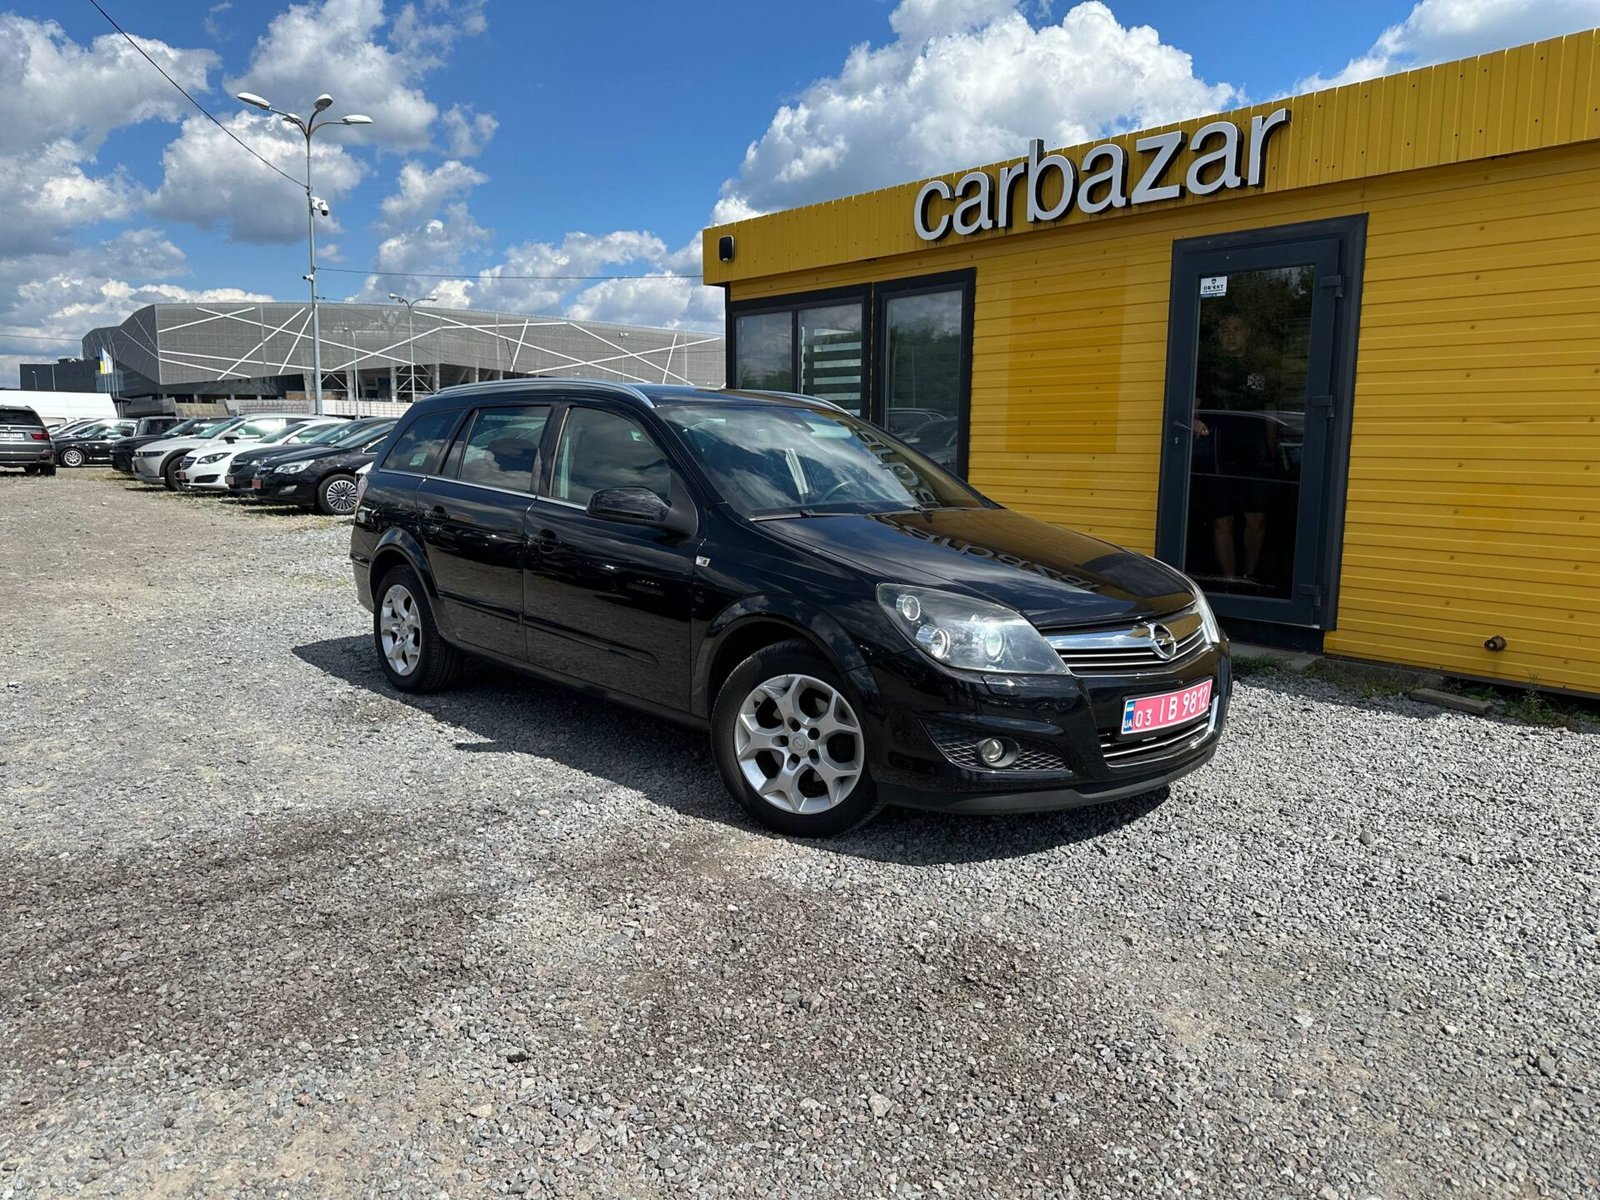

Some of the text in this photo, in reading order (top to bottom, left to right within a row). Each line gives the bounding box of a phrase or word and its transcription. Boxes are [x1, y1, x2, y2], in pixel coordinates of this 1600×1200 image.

[913, 108, 1292, 242] carbazar
[1135, 709, 1152, 727] 03
[1182, 686, 1208, 716] 9812
